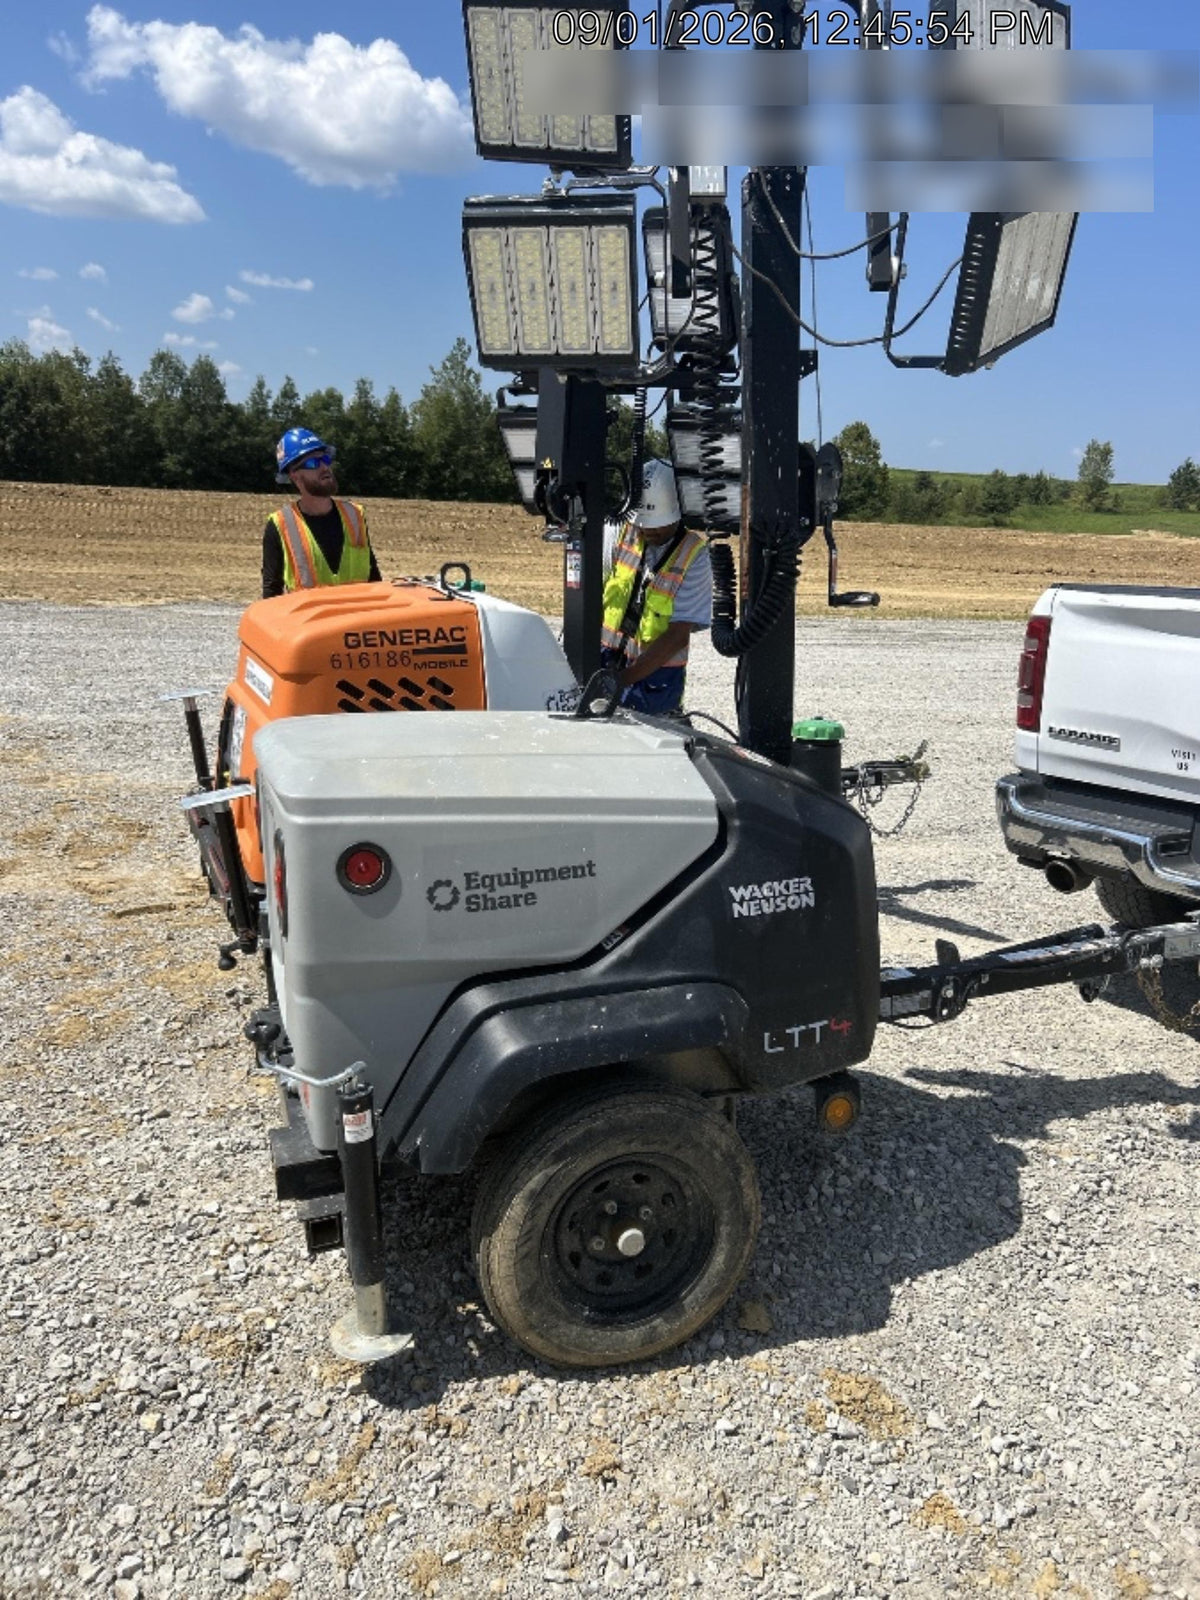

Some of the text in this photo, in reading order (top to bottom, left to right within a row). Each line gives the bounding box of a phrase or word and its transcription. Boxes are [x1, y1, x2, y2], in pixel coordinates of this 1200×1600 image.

[344, 626, 466, 649] GENERAC
[330, 650, 411, 670] 616186
[413, 659, 469, 670] MOBILE
[1176, 762, 1189, 771] US
[463, 860, 597, 893] Equipment
[728, 876, 814, 902] WACKER
[464, 891, 538, 913] Share
[732, 892, 816, 918] NEUSON
[763, 1017, 853, 1053] LTT4
